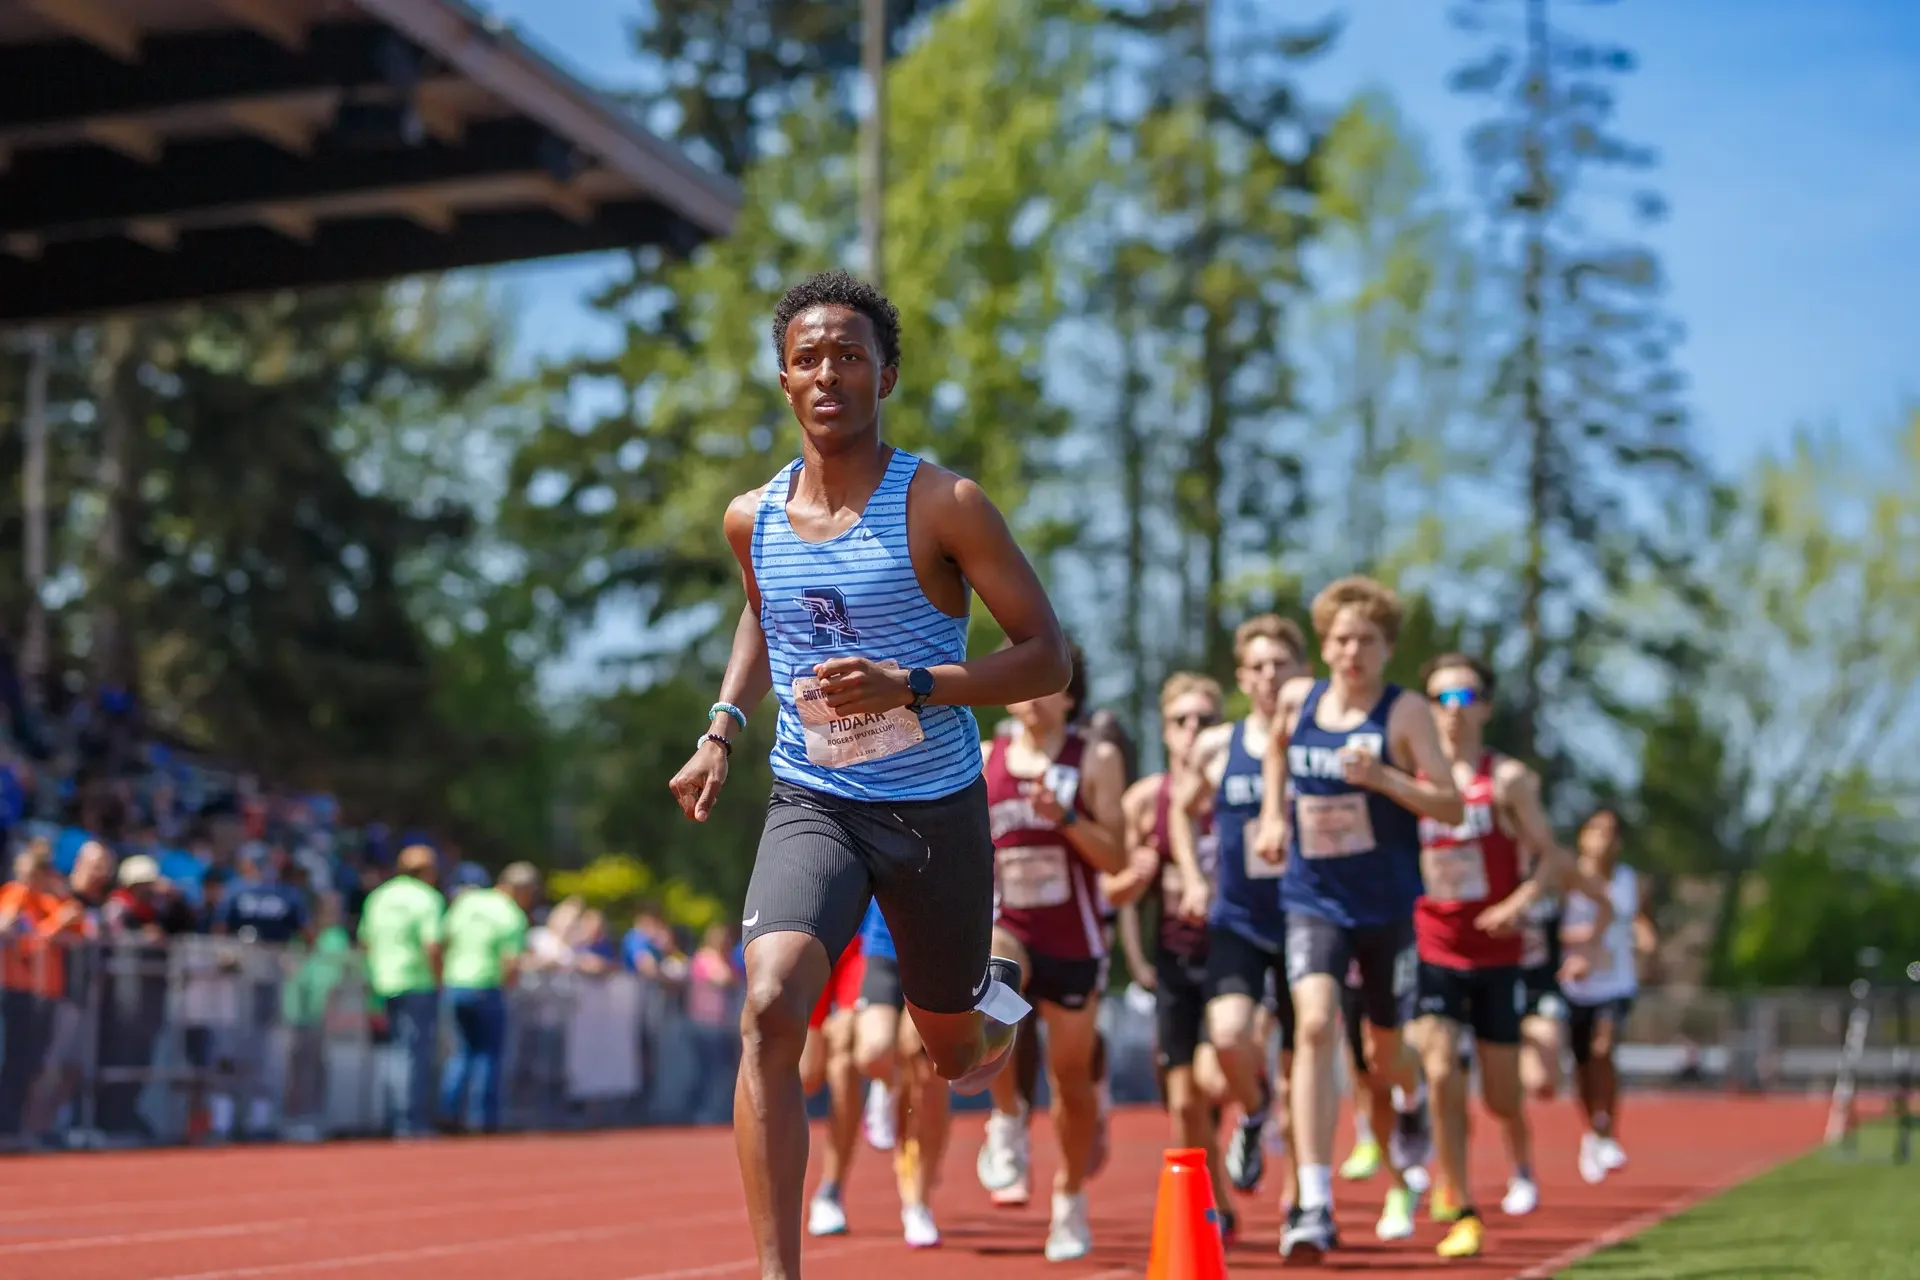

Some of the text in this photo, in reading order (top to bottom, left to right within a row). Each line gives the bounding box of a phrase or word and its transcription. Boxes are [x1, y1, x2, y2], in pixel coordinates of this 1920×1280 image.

[801, 584, 860, 649] R
[829, 711, 886, 734] FIDAAR
[828, 723, 896, 747] ROGERS (PUYALLUP)
